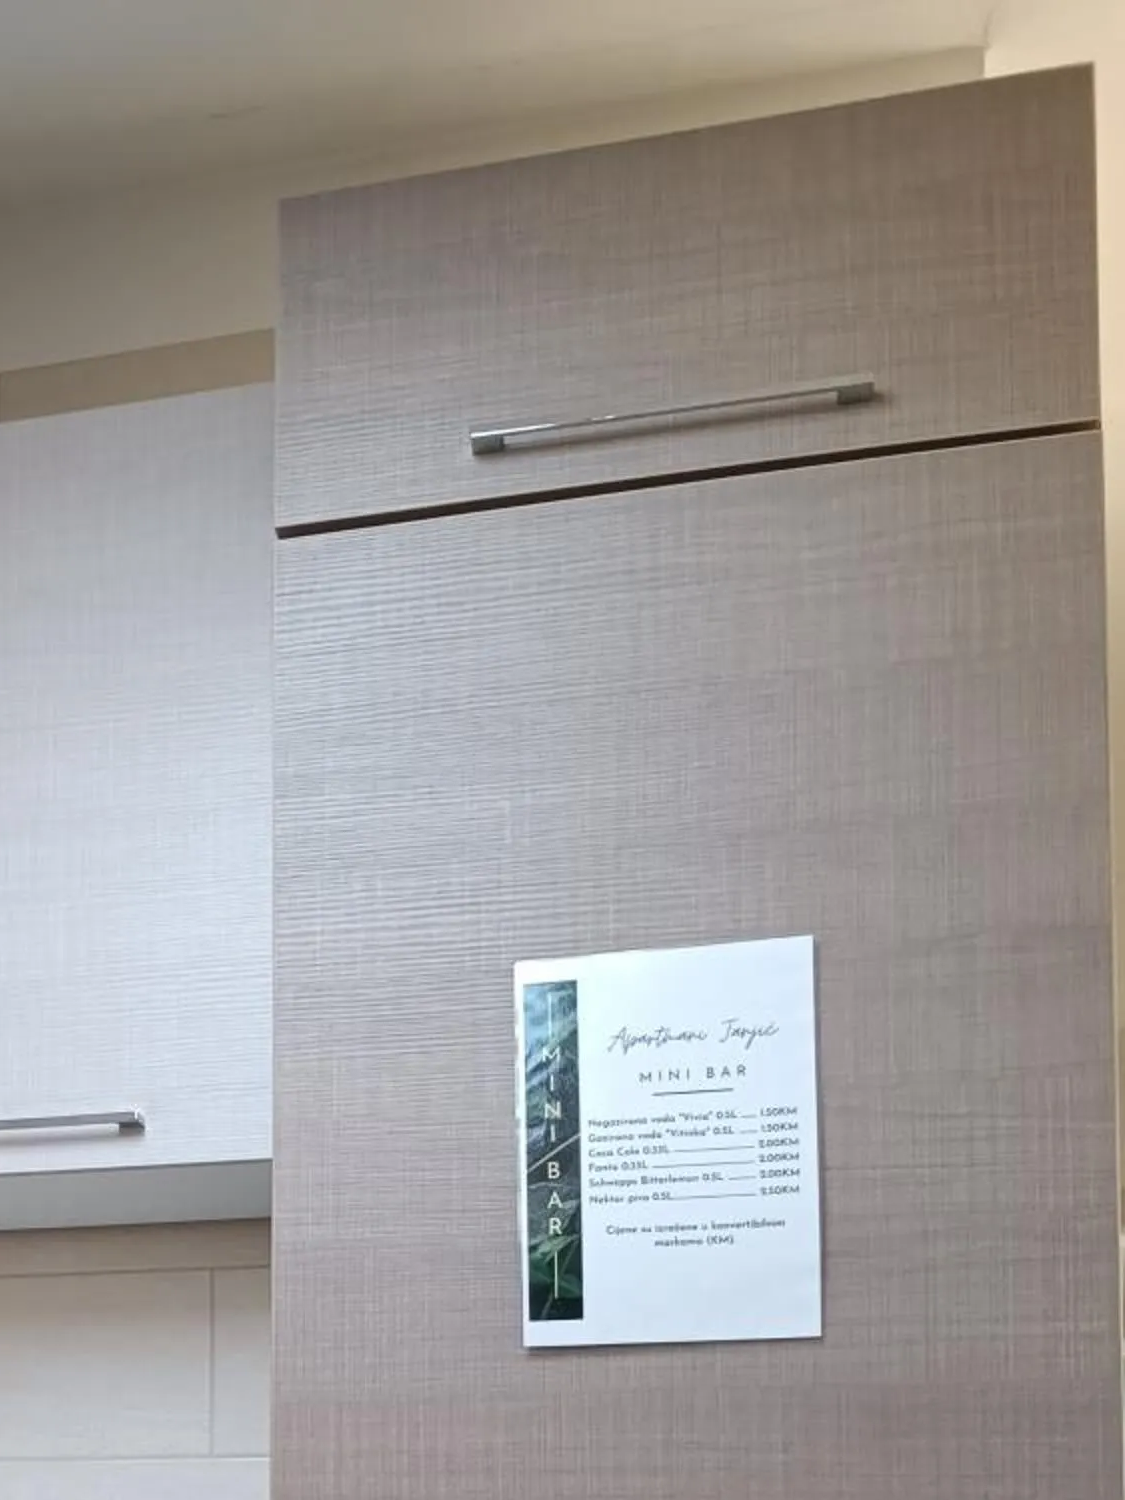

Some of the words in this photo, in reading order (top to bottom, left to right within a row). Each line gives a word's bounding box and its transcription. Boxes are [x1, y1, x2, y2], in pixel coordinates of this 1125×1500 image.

[542, 1046, 562, 1142] MINI
[638, 1067, 690, 1082] MINI
[706, 1064, 747, 1079] BAR
[546, 1161, 563, 1236] BAR
